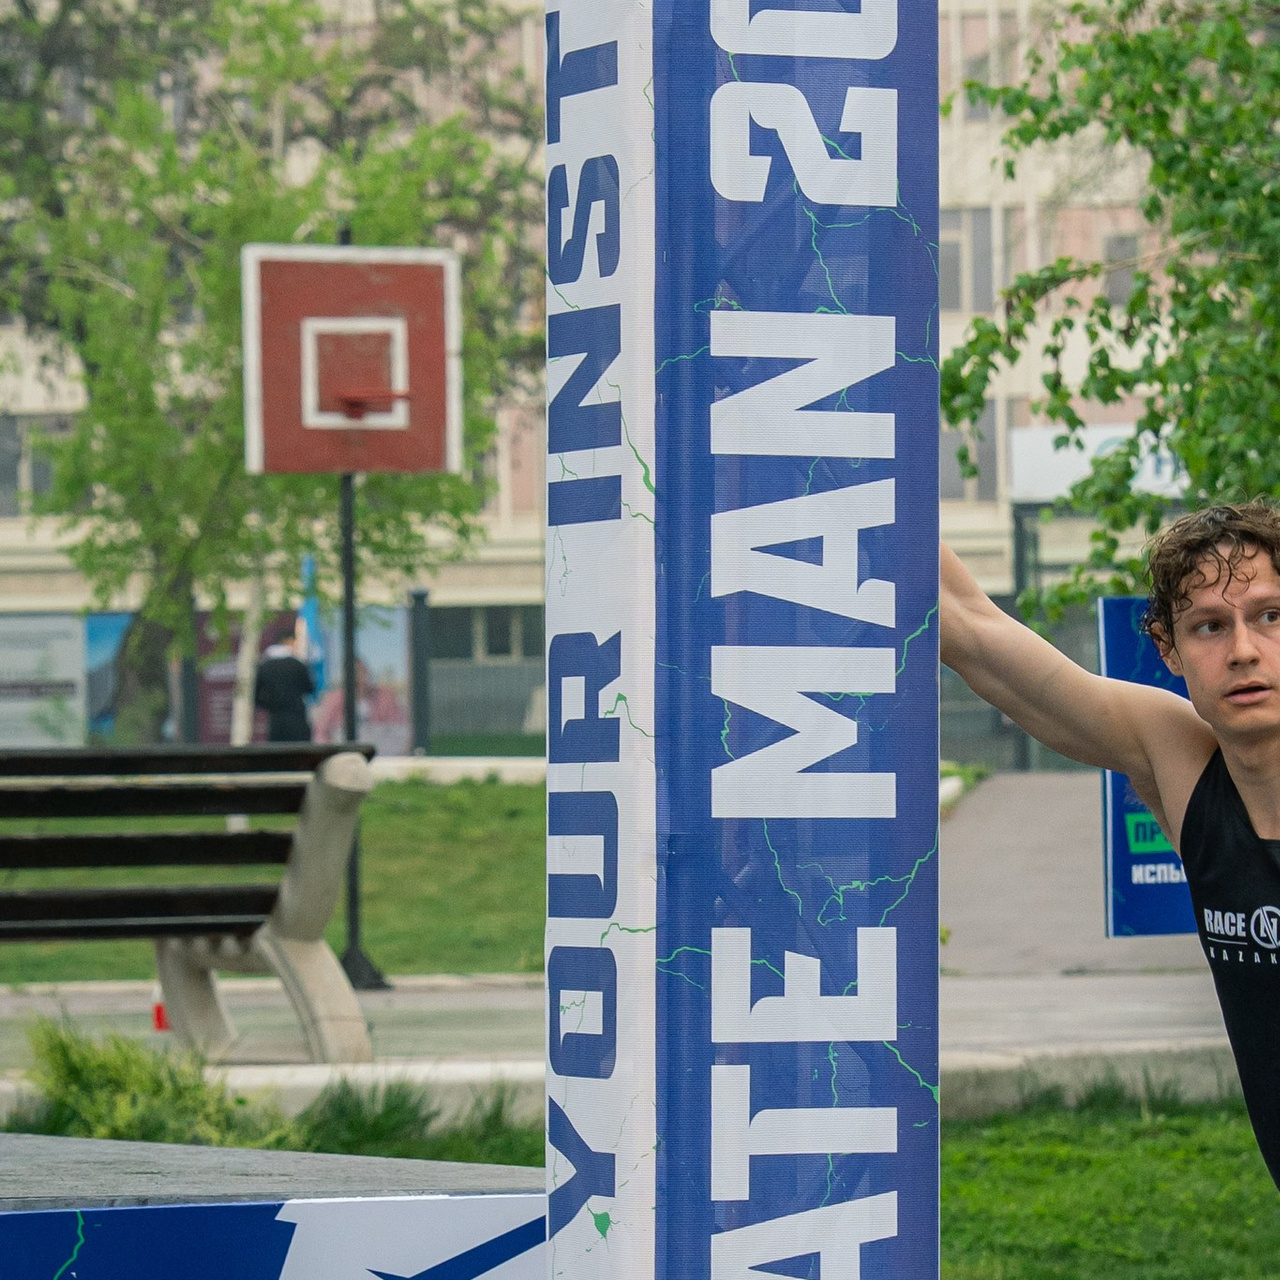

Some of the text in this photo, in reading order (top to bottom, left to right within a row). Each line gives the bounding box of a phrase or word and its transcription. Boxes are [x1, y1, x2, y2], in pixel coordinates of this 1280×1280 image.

[710, 310, 897, 819] MAN
[548, 630, 622, 1242] YOUR
[1204, 908, 1246, 937] RACE
